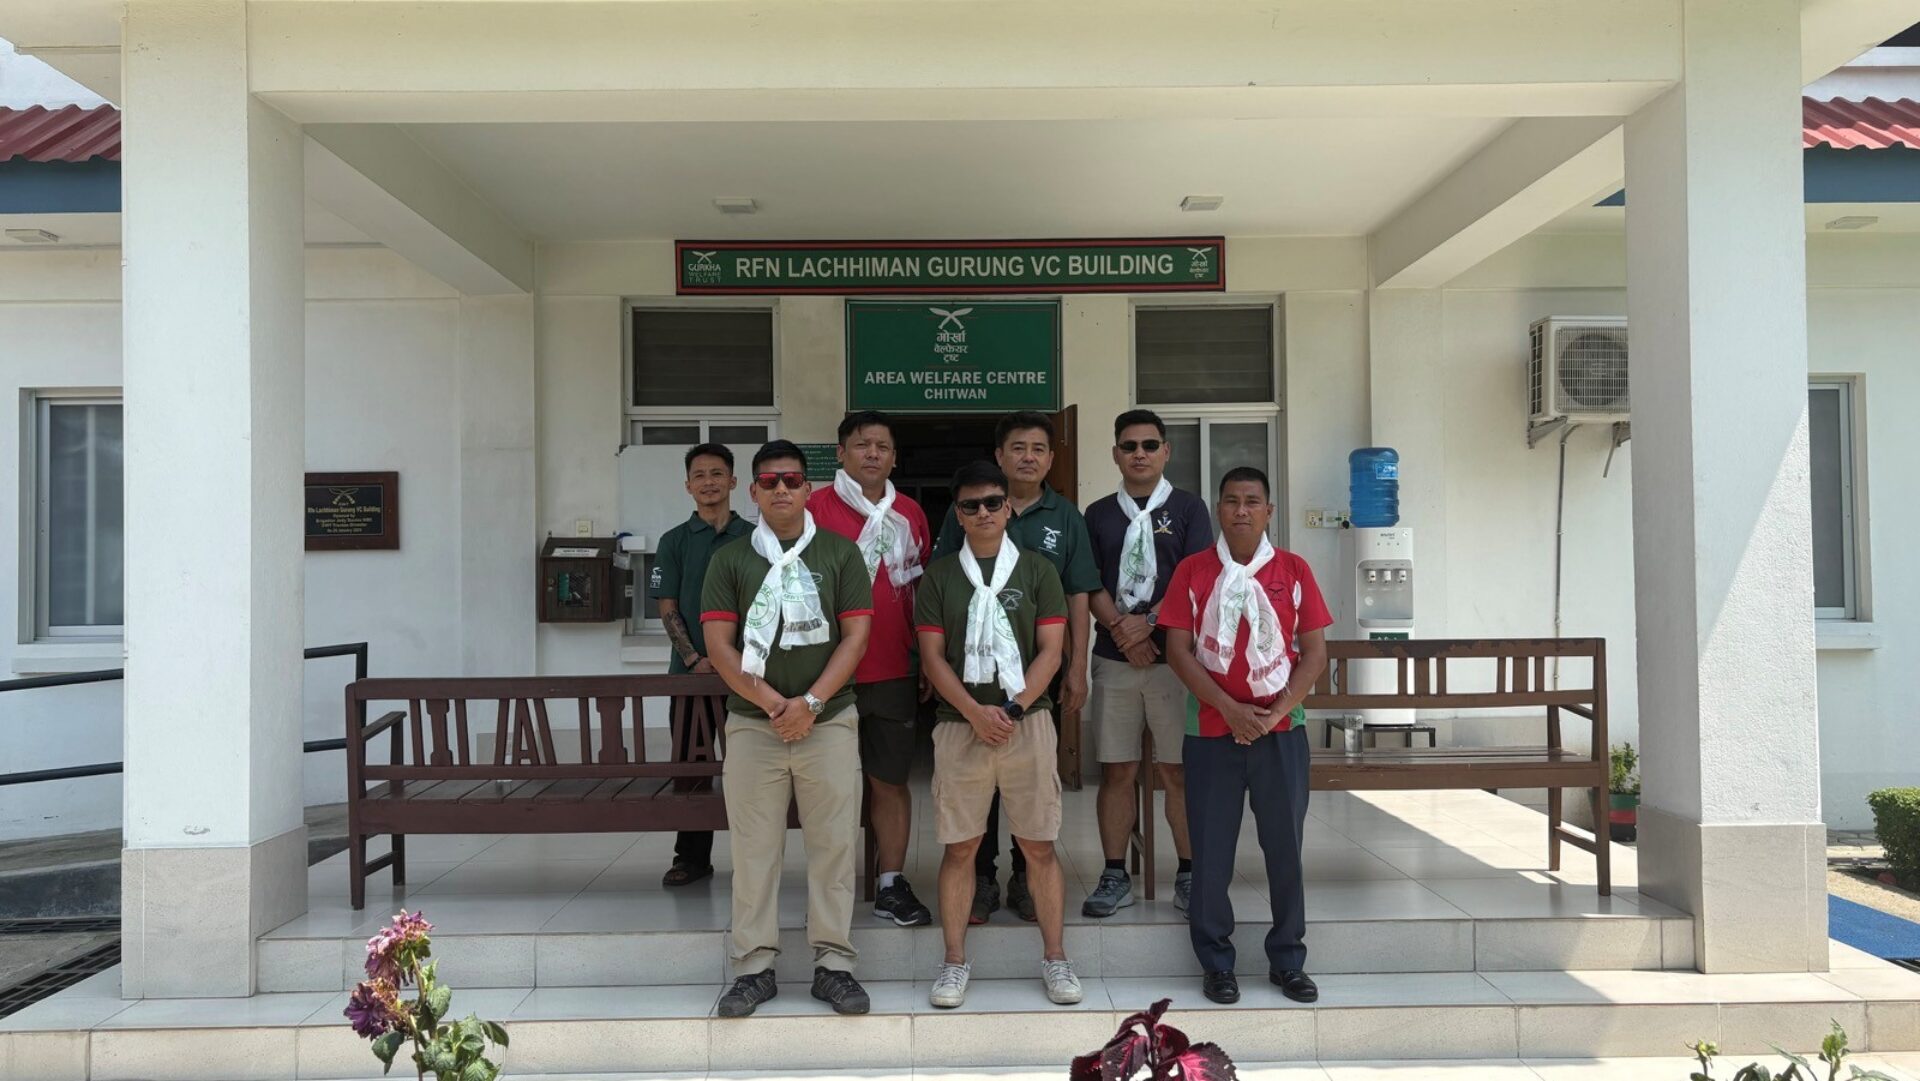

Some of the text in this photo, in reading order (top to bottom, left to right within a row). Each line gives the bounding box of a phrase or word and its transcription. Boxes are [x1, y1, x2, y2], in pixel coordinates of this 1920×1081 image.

[688, 263, 721, 272] GURKHA
[736, 254, 1174, 277] RFN LACHHIMAN GURUNG VC BUILDING
[864, 371, 1046, 384] AREA WELFARE CENTRE
[924, 388, 987, 400] CHITWAN
